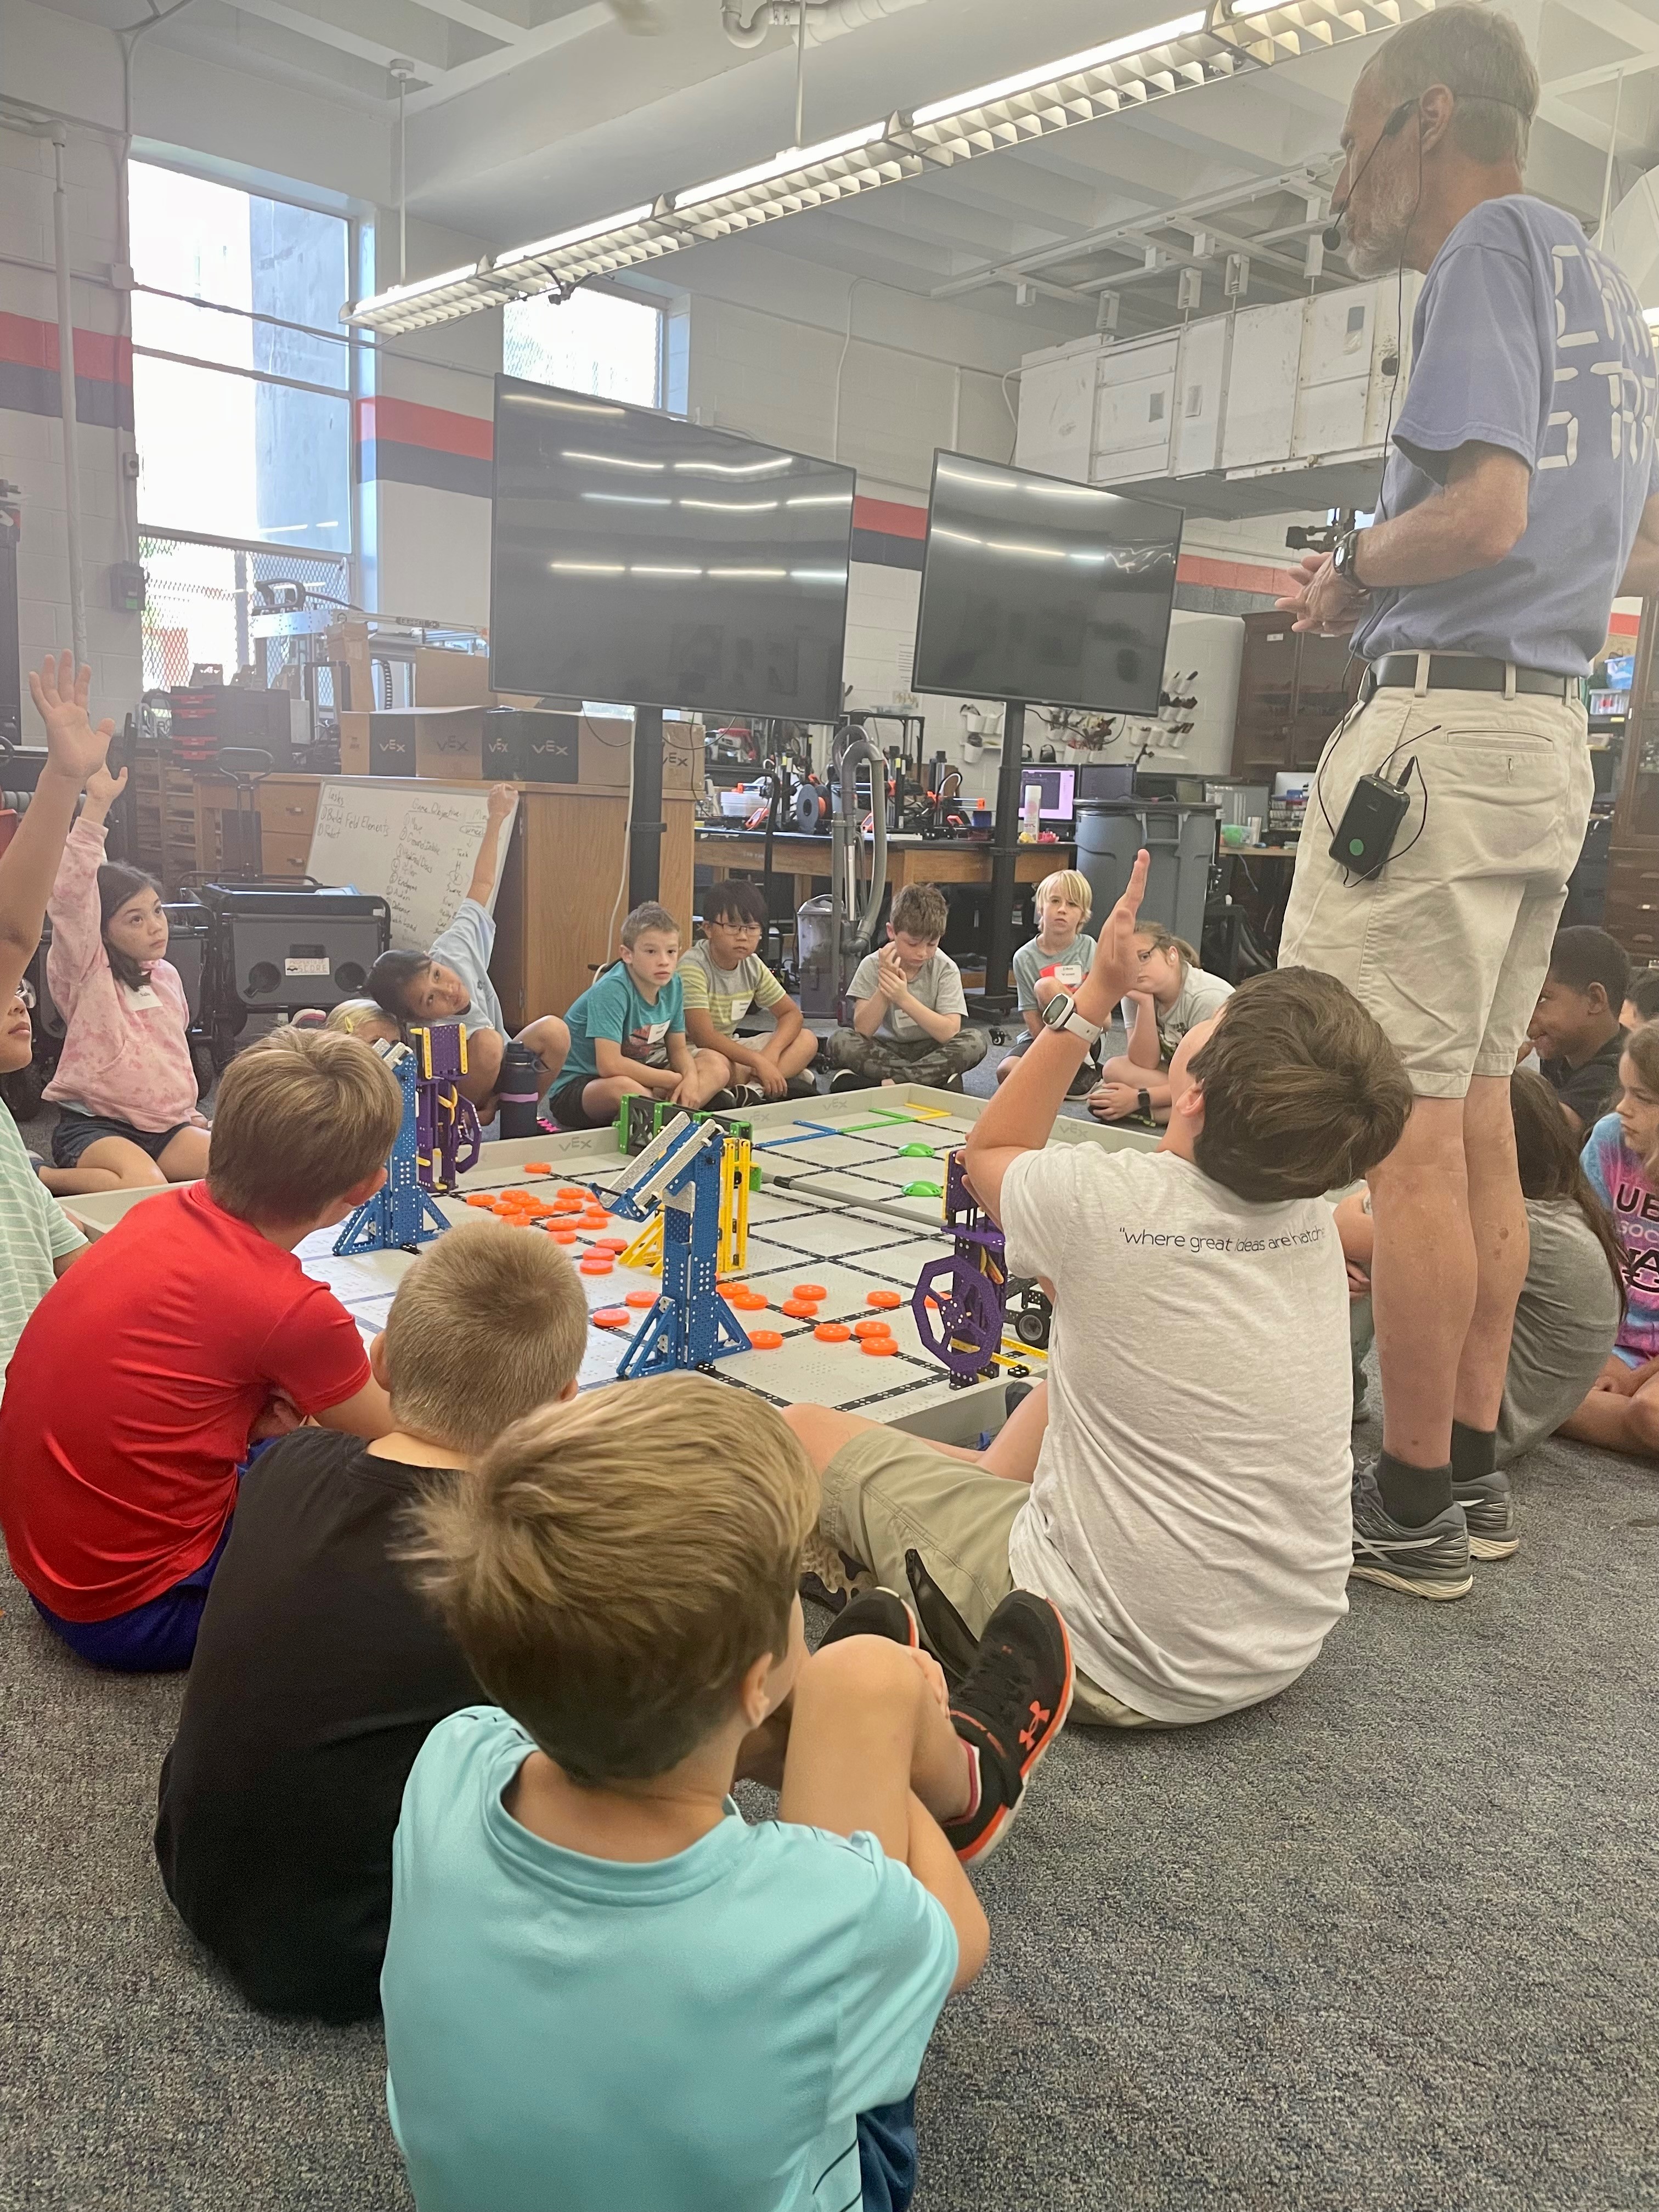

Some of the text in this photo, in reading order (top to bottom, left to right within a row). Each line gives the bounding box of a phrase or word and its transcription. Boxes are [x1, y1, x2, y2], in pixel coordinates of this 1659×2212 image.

[1537, 361, 1656, 470] STAF
[380, 739, 405, 753] VEX
[437, 735, 469, 752] VEX
[489, 738, 509, 753] VEX
[532, 740, 568, 755] VEX
[823, 1099, 848, 1111] VEX
[1059, 1122, 1088, 1138] VEX
[558, 1136, 592, 1152] VEX
[1120, 1226, 1325, 1252] "where great ideas are hatch
[1617, 1220, 1659, 1244] SOC
